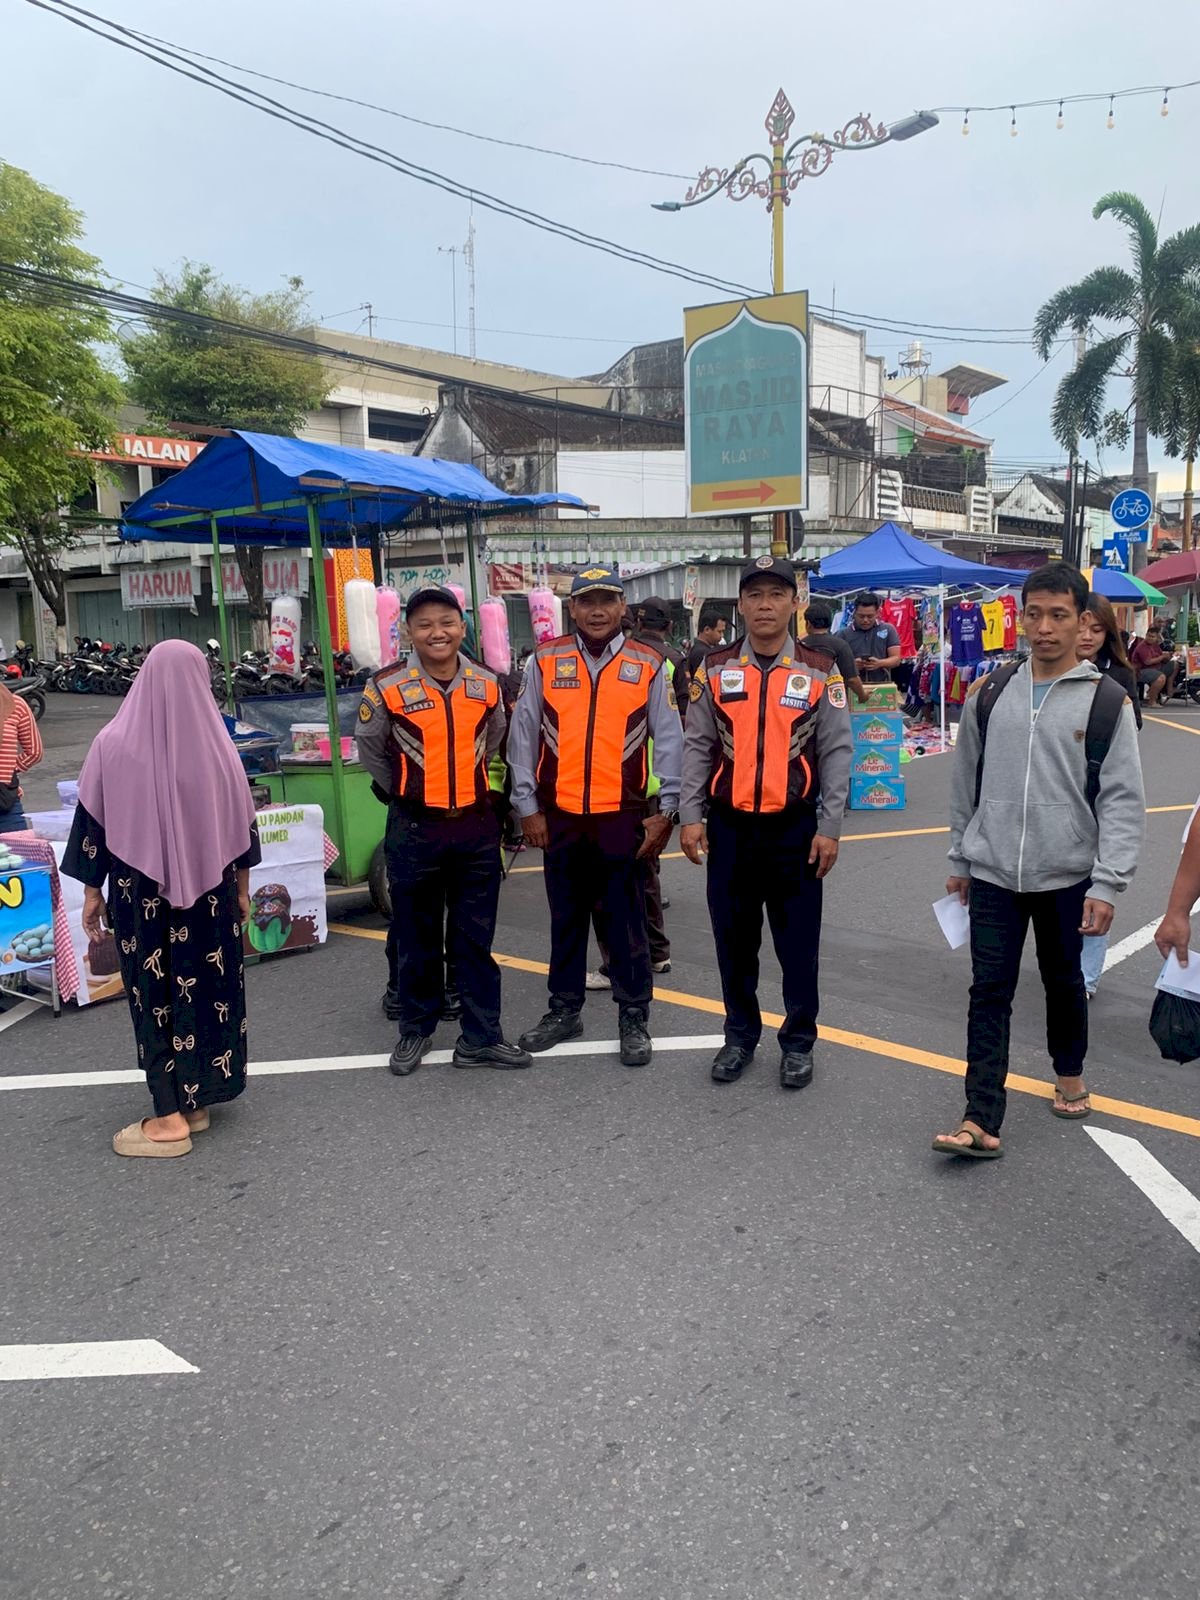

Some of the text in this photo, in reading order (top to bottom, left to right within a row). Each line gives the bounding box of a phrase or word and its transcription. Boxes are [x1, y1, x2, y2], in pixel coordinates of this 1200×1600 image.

[694, 377, 797, 411] MASJID
[703, 411, 785, 443] RAYA
[128, 568, 193, 599] HARUM
[221, 559, 299, 592] HAUM
[893, 610, 903, 627] 7
[988, 618, 995, 634] 7
[858, 731, 895, 740] Minerale
[855, 764, 892, 772] Minerale
[861, 796, 898, 804] Minerale
[269, 810, 304, 825] PANDAN
[261, 829, 289, 844] LUMER
